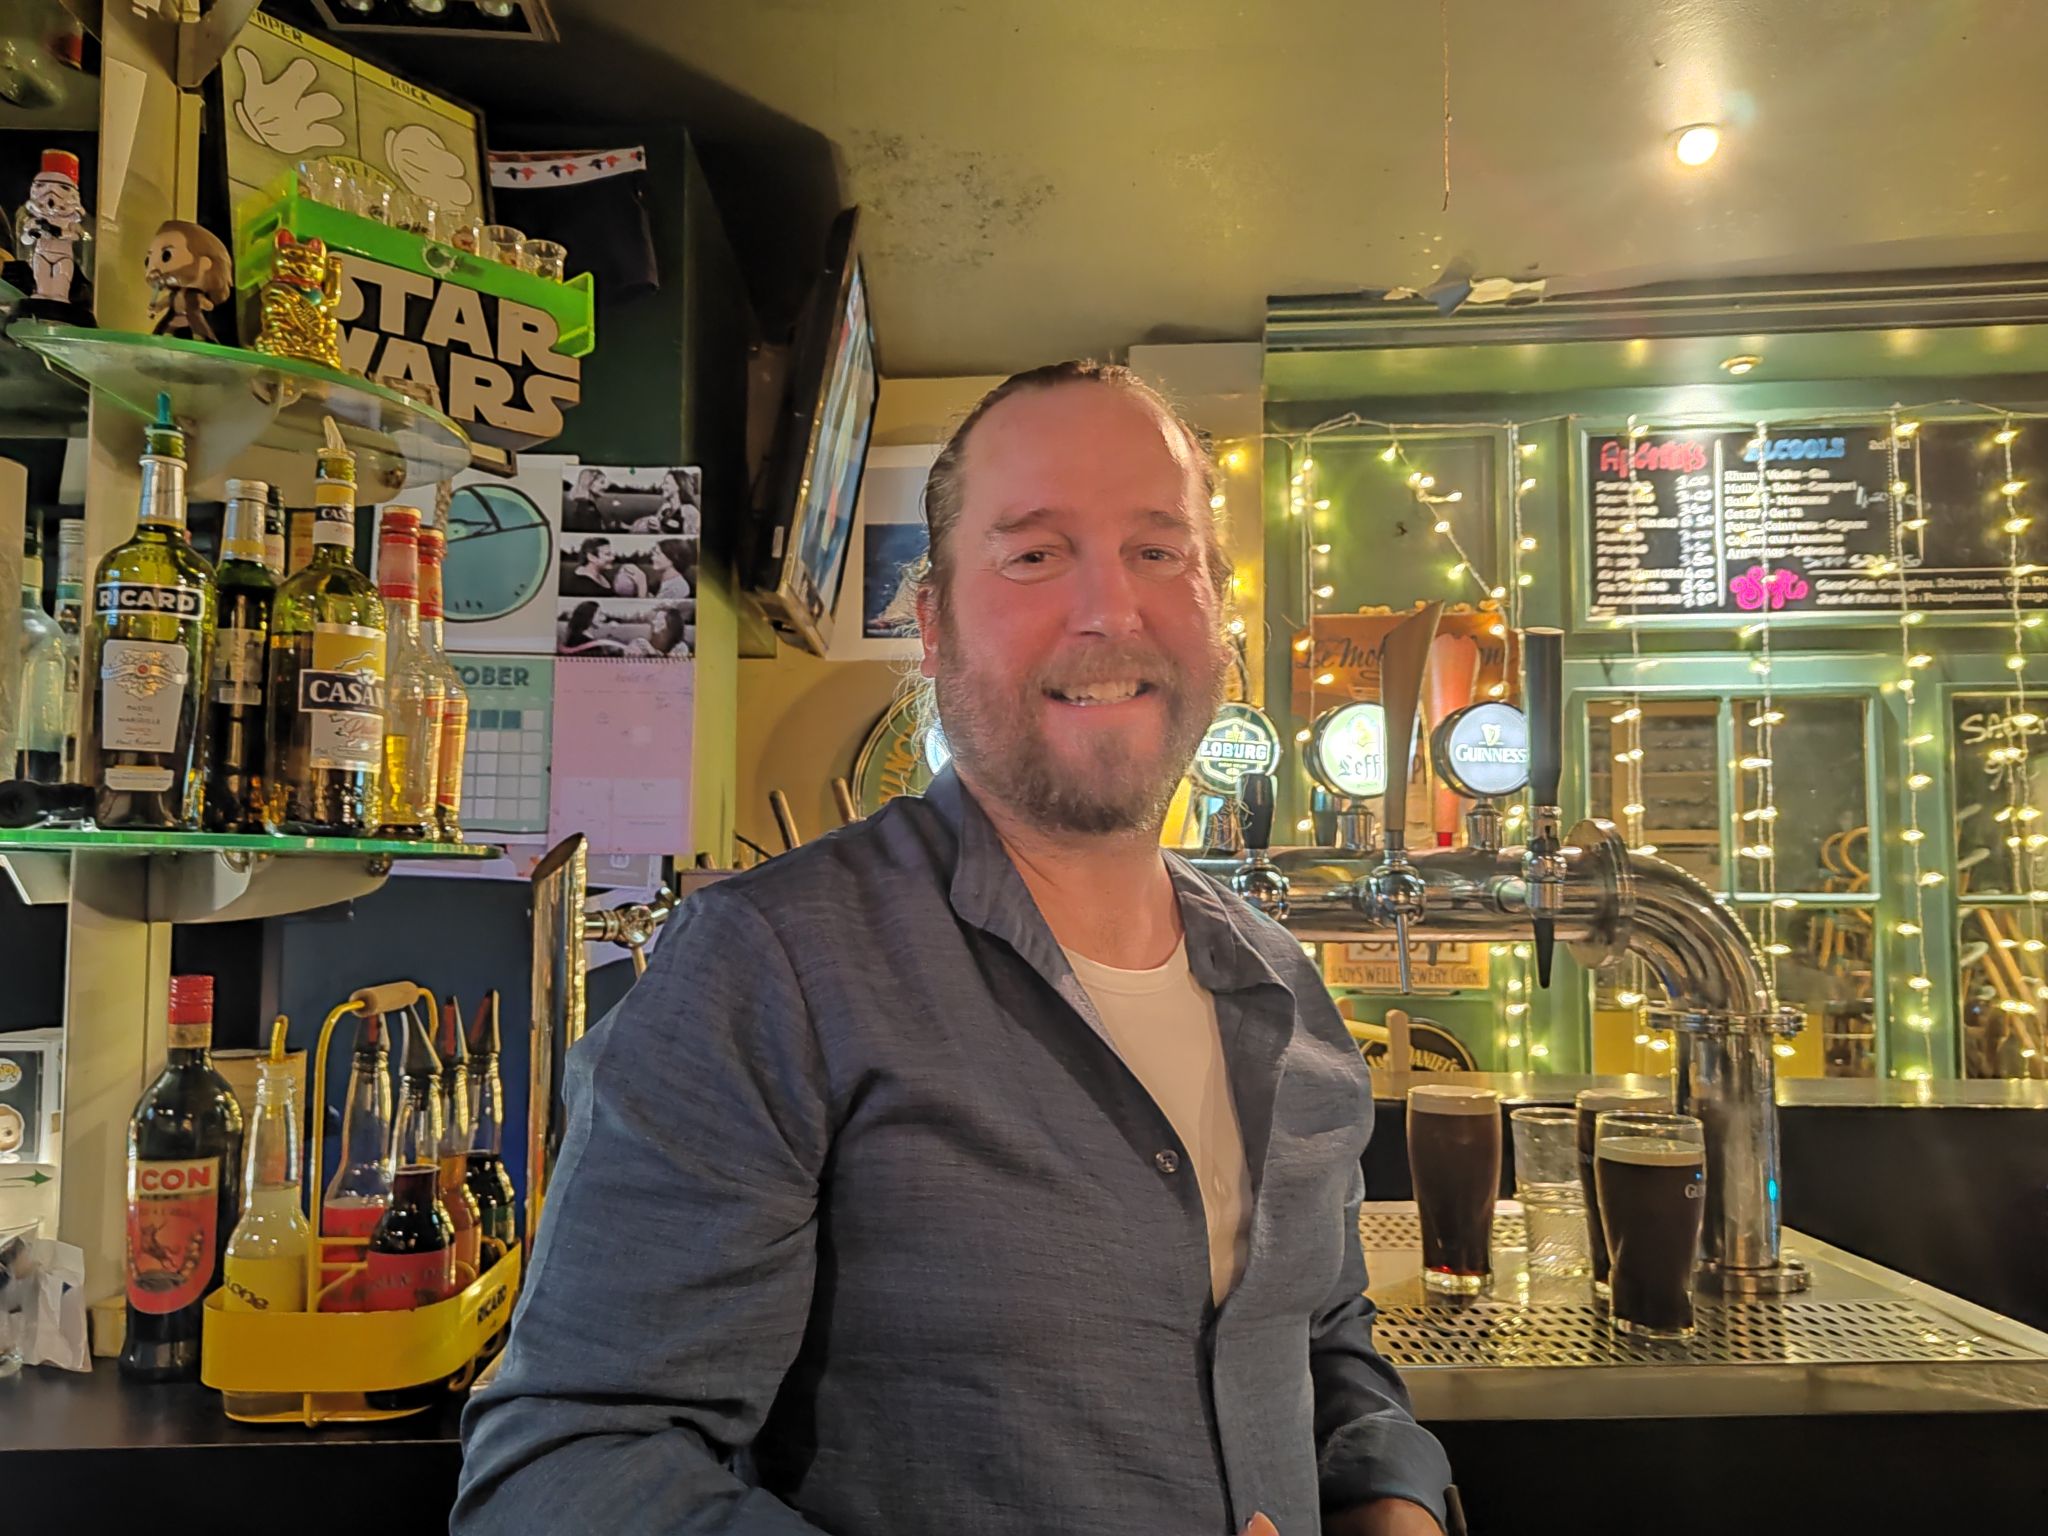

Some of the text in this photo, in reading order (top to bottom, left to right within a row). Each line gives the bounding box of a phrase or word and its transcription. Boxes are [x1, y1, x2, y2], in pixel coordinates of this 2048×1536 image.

[99, 589, 196, 612] RICARD
[453, 664, 530, 687] OBER
[1199, 741, 1267, 761] LOBURG
[1455, 744, 1529, 764] GUINNESS
